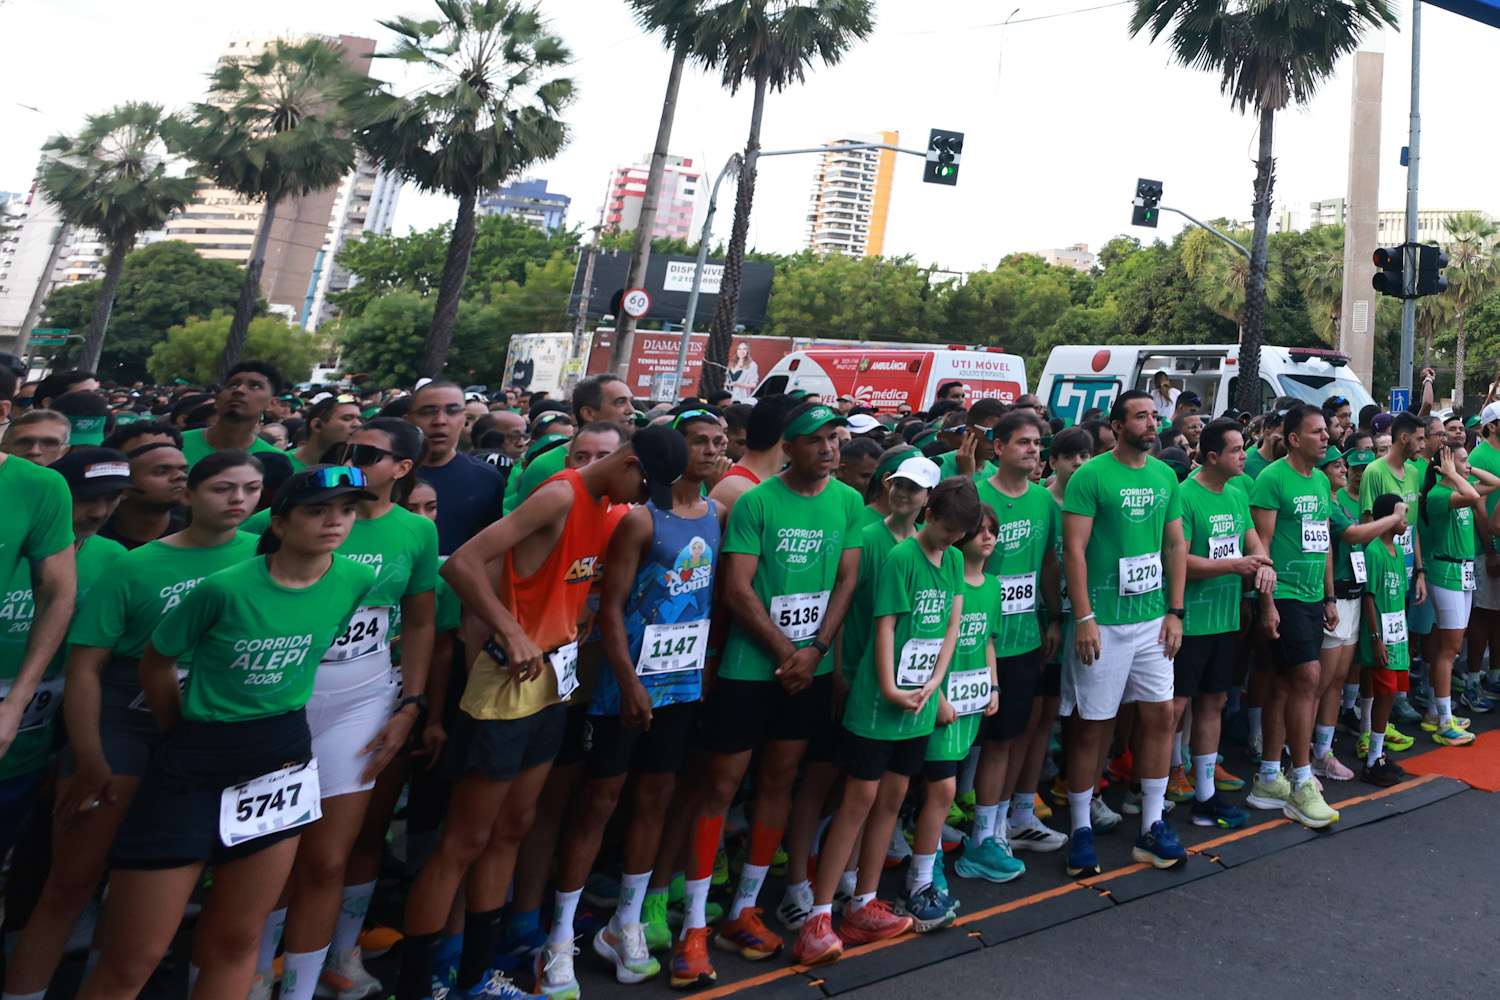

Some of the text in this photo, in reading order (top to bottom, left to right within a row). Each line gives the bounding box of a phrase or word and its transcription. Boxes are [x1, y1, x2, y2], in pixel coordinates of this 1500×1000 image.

[630, 295, 645, 307] 60
[952, 359, 1010, 371] UTI MÓVEL
[872, 389, 908, 400] médica
[972, 388, 1014, 400] médica
[1120, 488, 1154, 497] CORRIDA
[1121, 495, 1155, 508] ALEPI
[1294, 502, 1318, 514] ALEPI
[1130, 508, 1145, 516] 2026
[1209, 513, 1233, 523] CORRIDA
[777, 528, 823, 539] CORRIDA
[1212, 521, 1235, 535] ALEPI
[995, 527, 1031, 543] ALEPI
[1304, 530, 1328, 541] 6165
[775, 538, 823, 553] ALEPI
[1004, 541, 1021, 551] 2026
[1213, 543, 1235, 560] 6004
[786, 554, 807, 564] 2026
[1127, 564, 1157, 583] 1270
[1000, 584, 1033, 601] 6268
[779, 606, 819, 627] 5136
[922, 615, 941, 624] 2026
[959, 612, 987, 621] ORRIDA
[331, 617, 379, 648] 324
[234, 634, 313, 652] CORRIDA
[650, 635, 698, 659] 1147
[959, 638, 977, 647] 2026
[230, 647, 309, 671] ALEPI
[907, 653, 937, 671] 129
[243, 672, 283, 685] 2026
[951, 682, 988, 702] 1290
[236, 782, 302, 822] 5747
